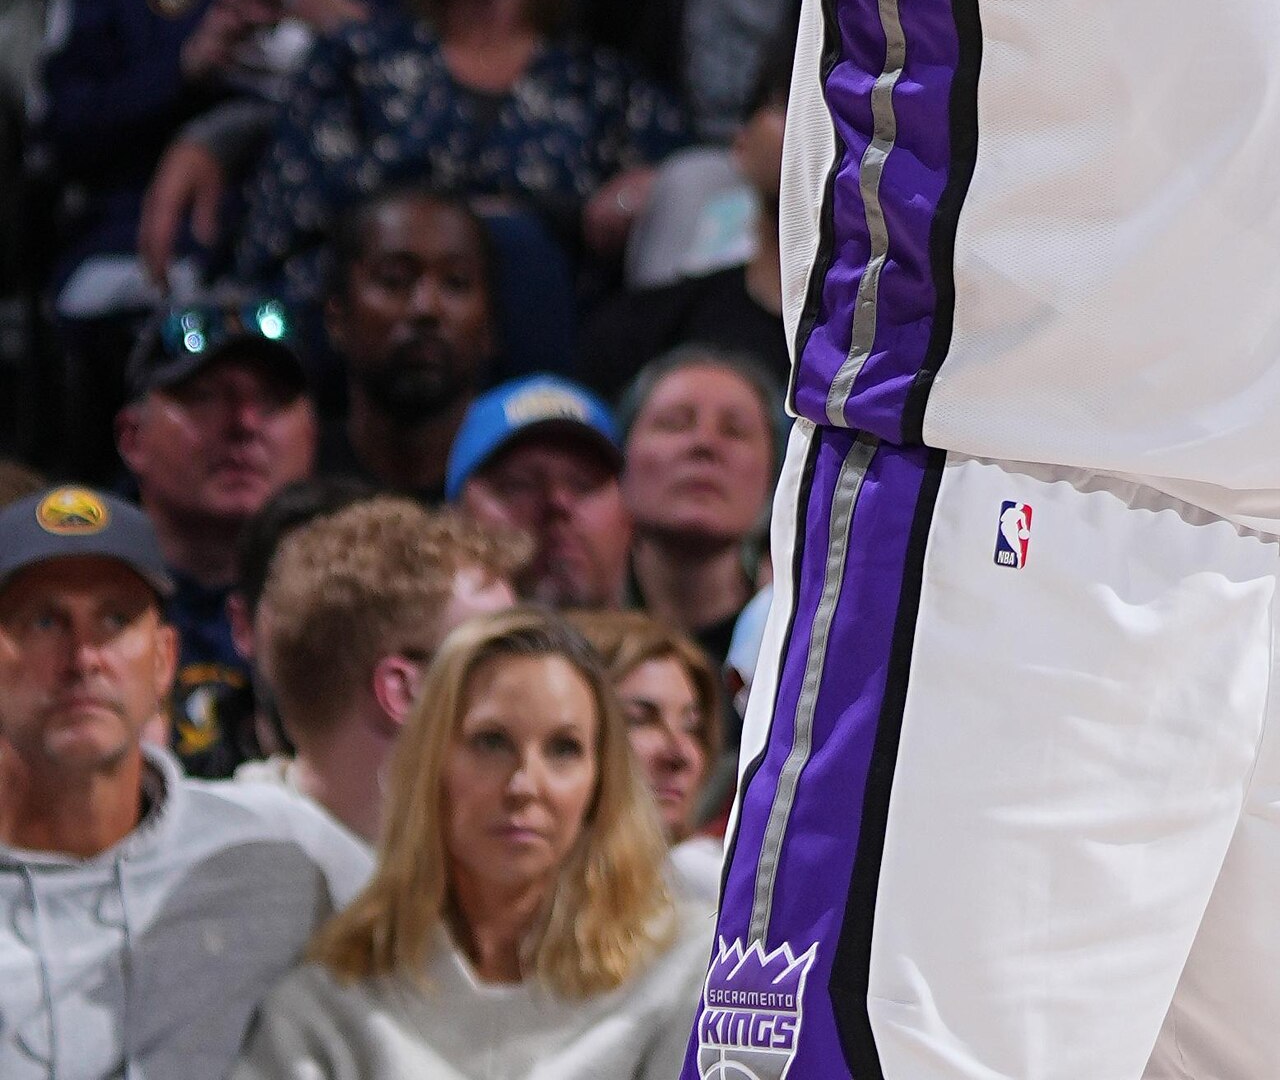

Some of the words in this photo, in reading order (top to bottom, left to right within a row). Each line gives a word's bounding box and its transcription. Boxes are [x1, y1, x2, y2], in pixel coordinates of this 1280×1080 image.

[997, 550, 1016, 566] NBA
[709, 989, 794, 1008] SACRAMENTO
[701, 1010, 797, 1050] KINGS
